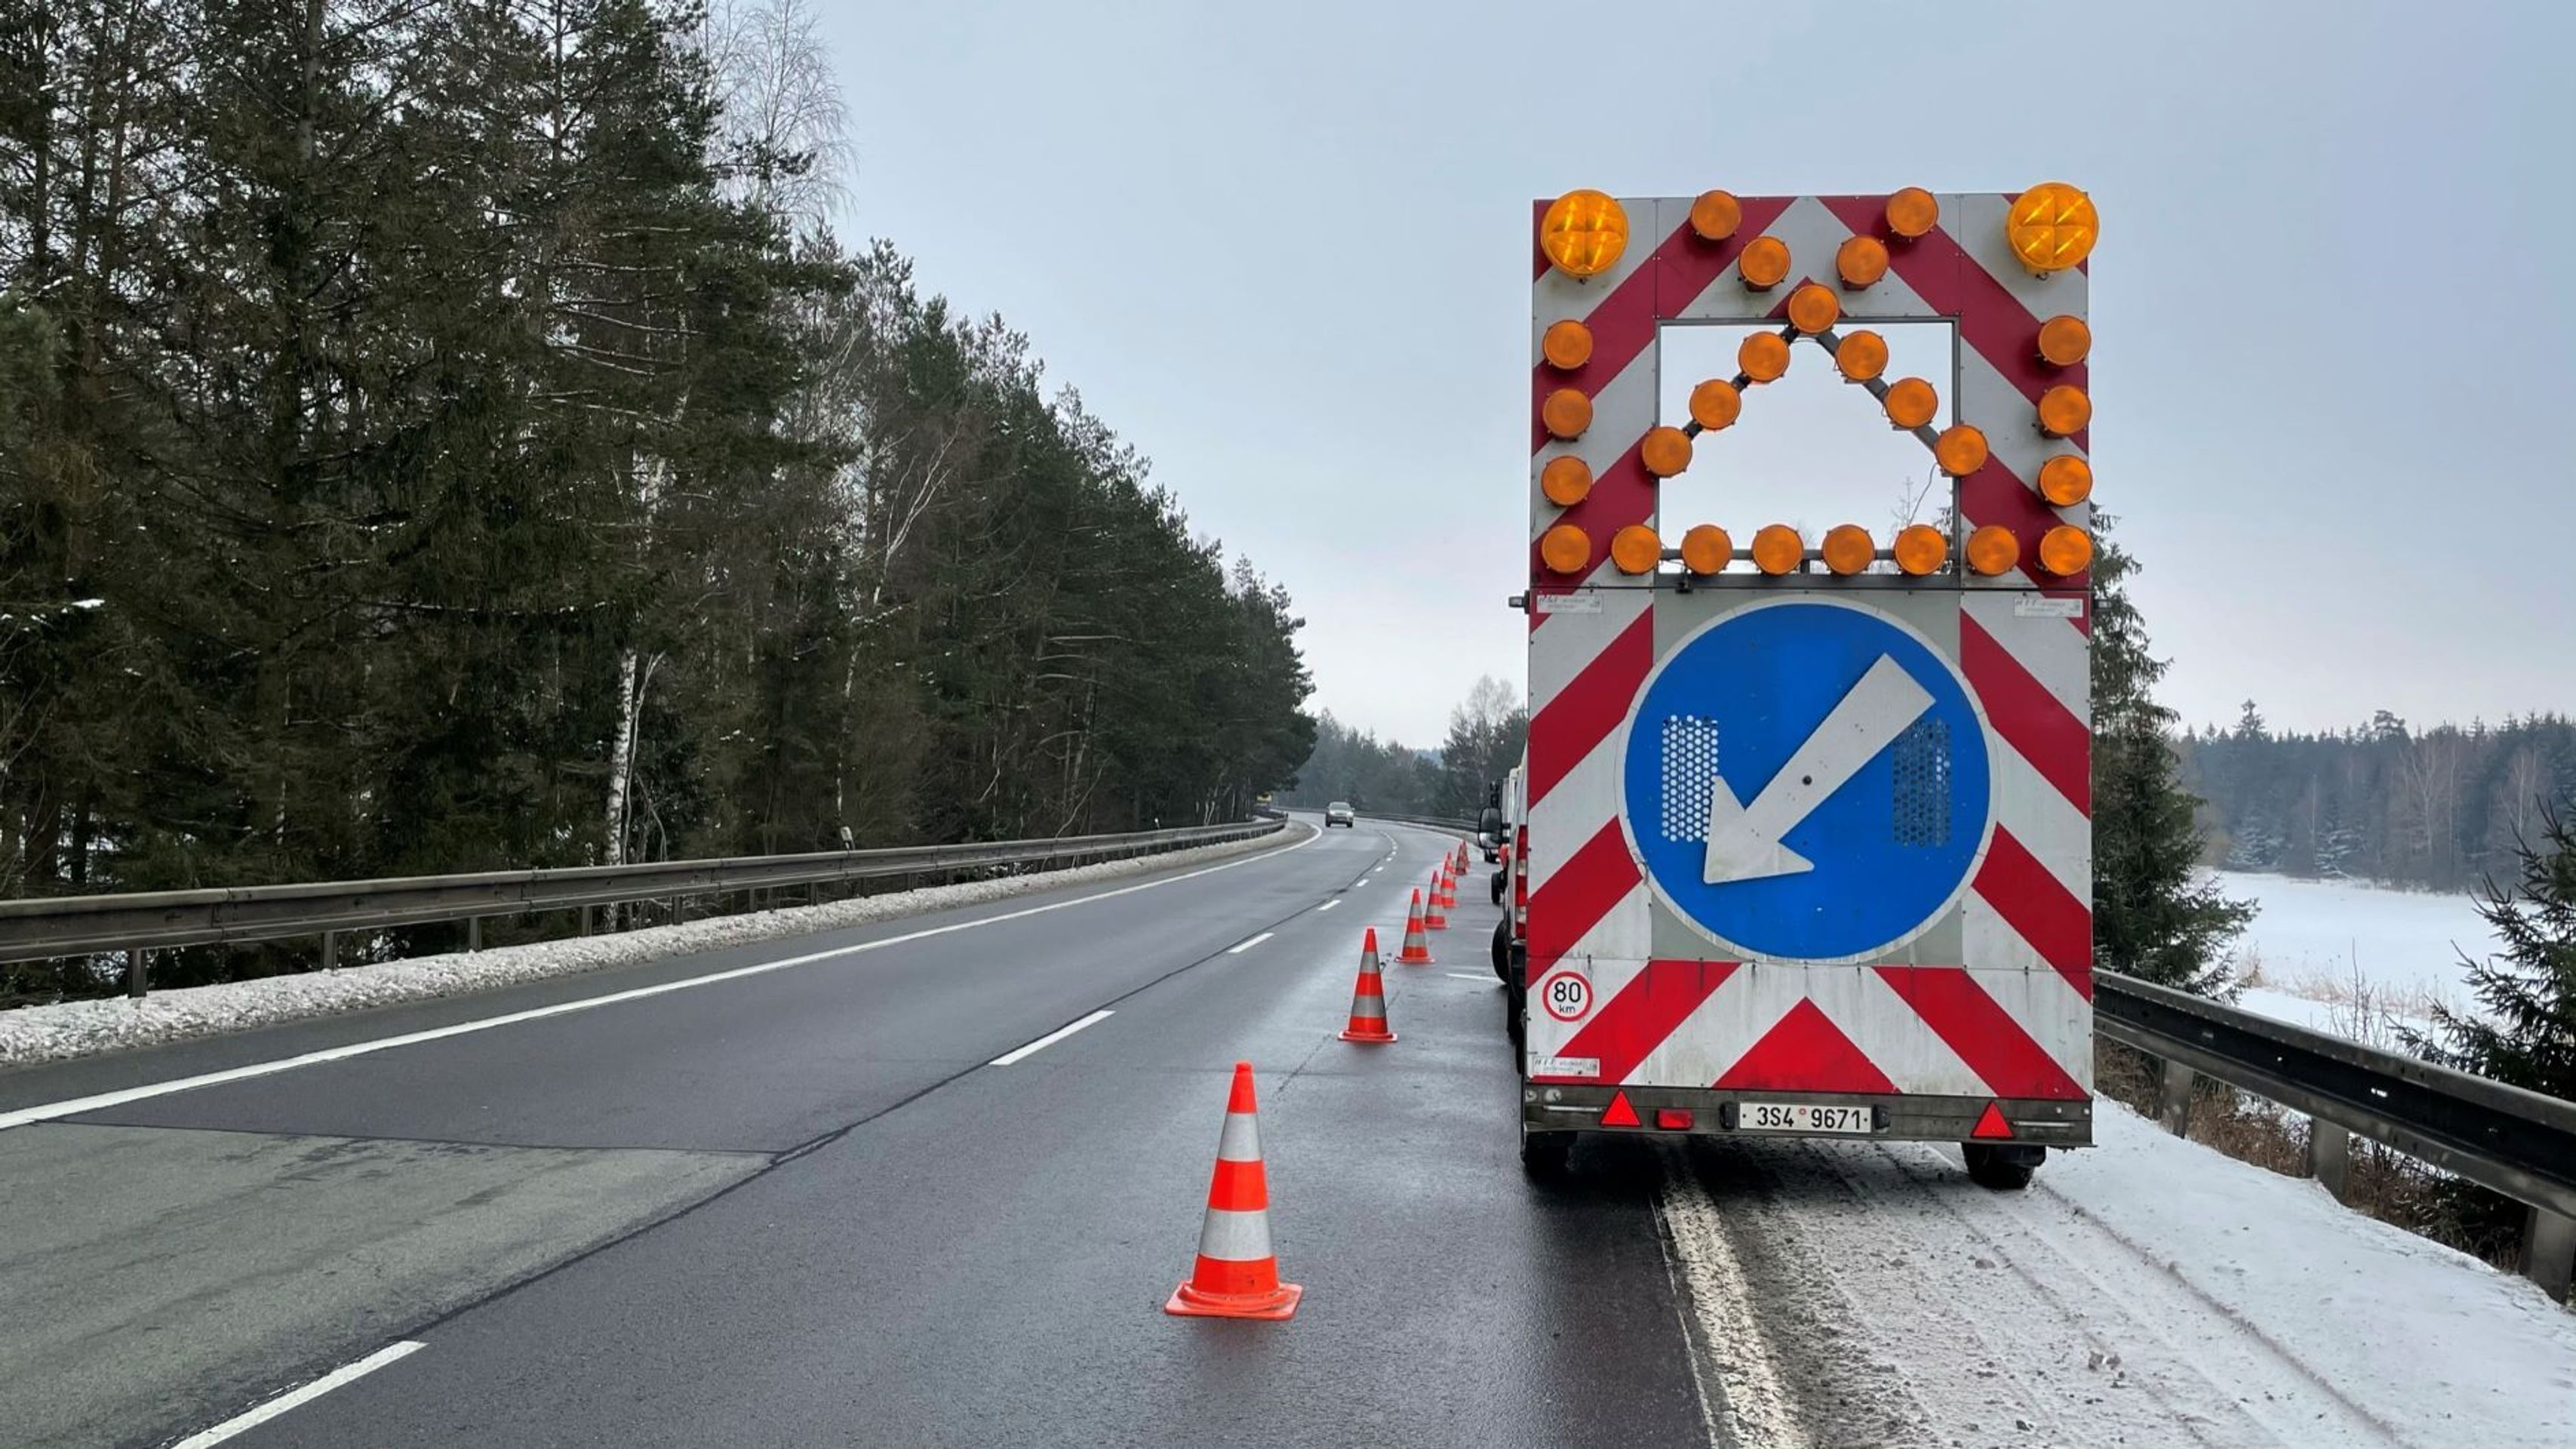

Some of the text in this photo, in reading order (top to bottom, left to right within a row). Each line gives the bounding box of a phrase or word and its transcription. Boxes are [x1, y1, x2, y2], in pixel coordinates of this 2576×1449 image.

[1554, 981, 1581, 1003] 80
[1559, 1004, 1575, 1013] km
[1757, 1106, 1860, 1129] 3S4 9671
